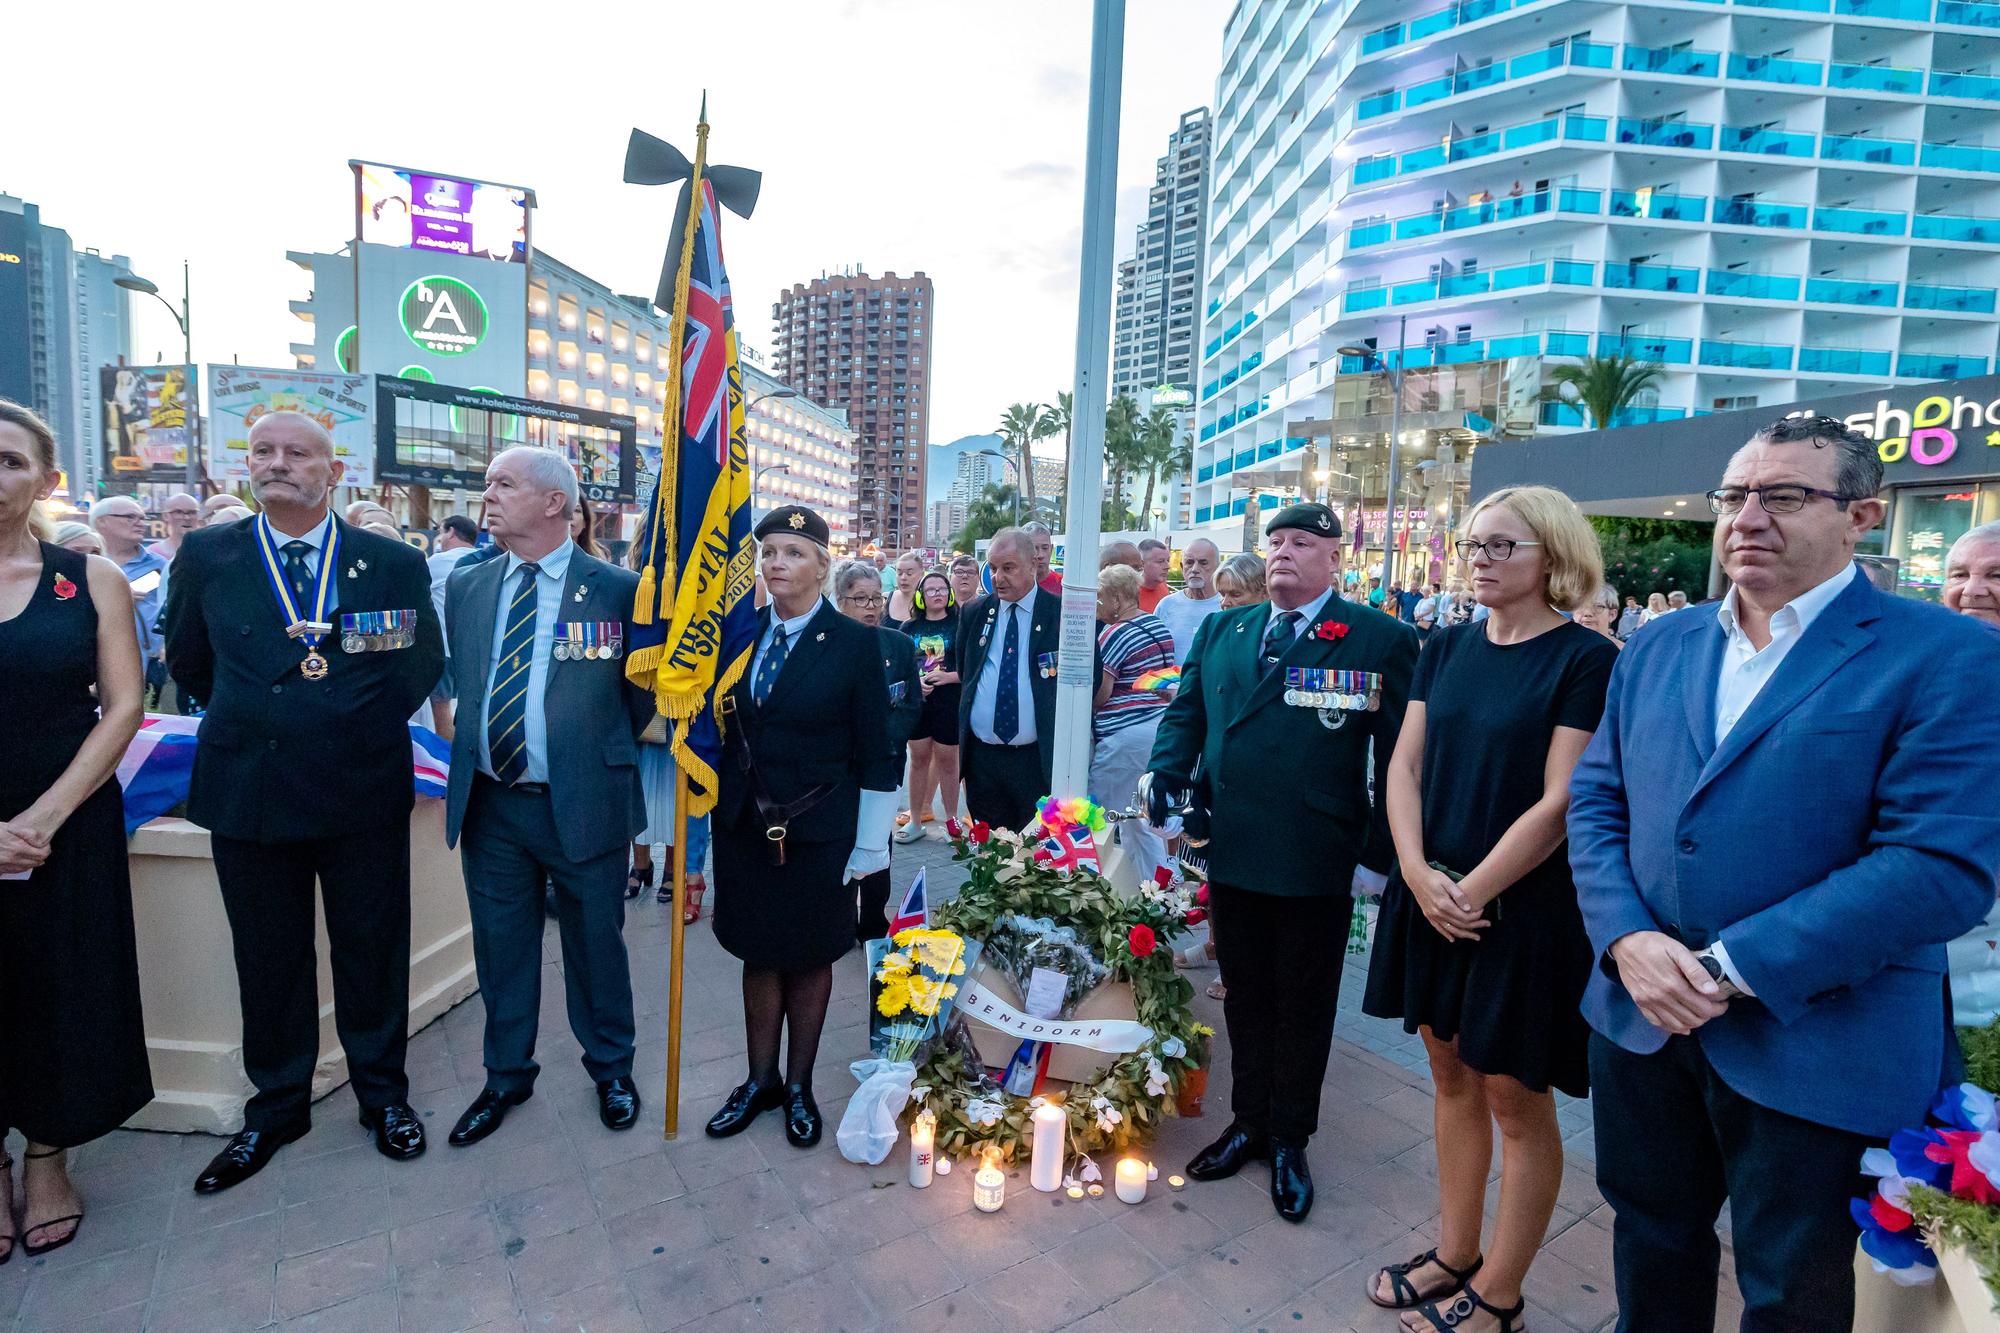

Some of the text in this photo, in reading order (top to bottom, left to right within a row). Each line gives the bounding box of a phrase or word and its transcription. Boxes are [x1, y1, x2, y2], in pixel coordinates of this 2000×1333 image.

[455, 394, 579, 420] www.hotelesbenidorm.com
[697, 526, 729, 598] OYAL
[728, 575, 752, 603] 2013
[968, 993, 1102, 1036] BENIDORM
